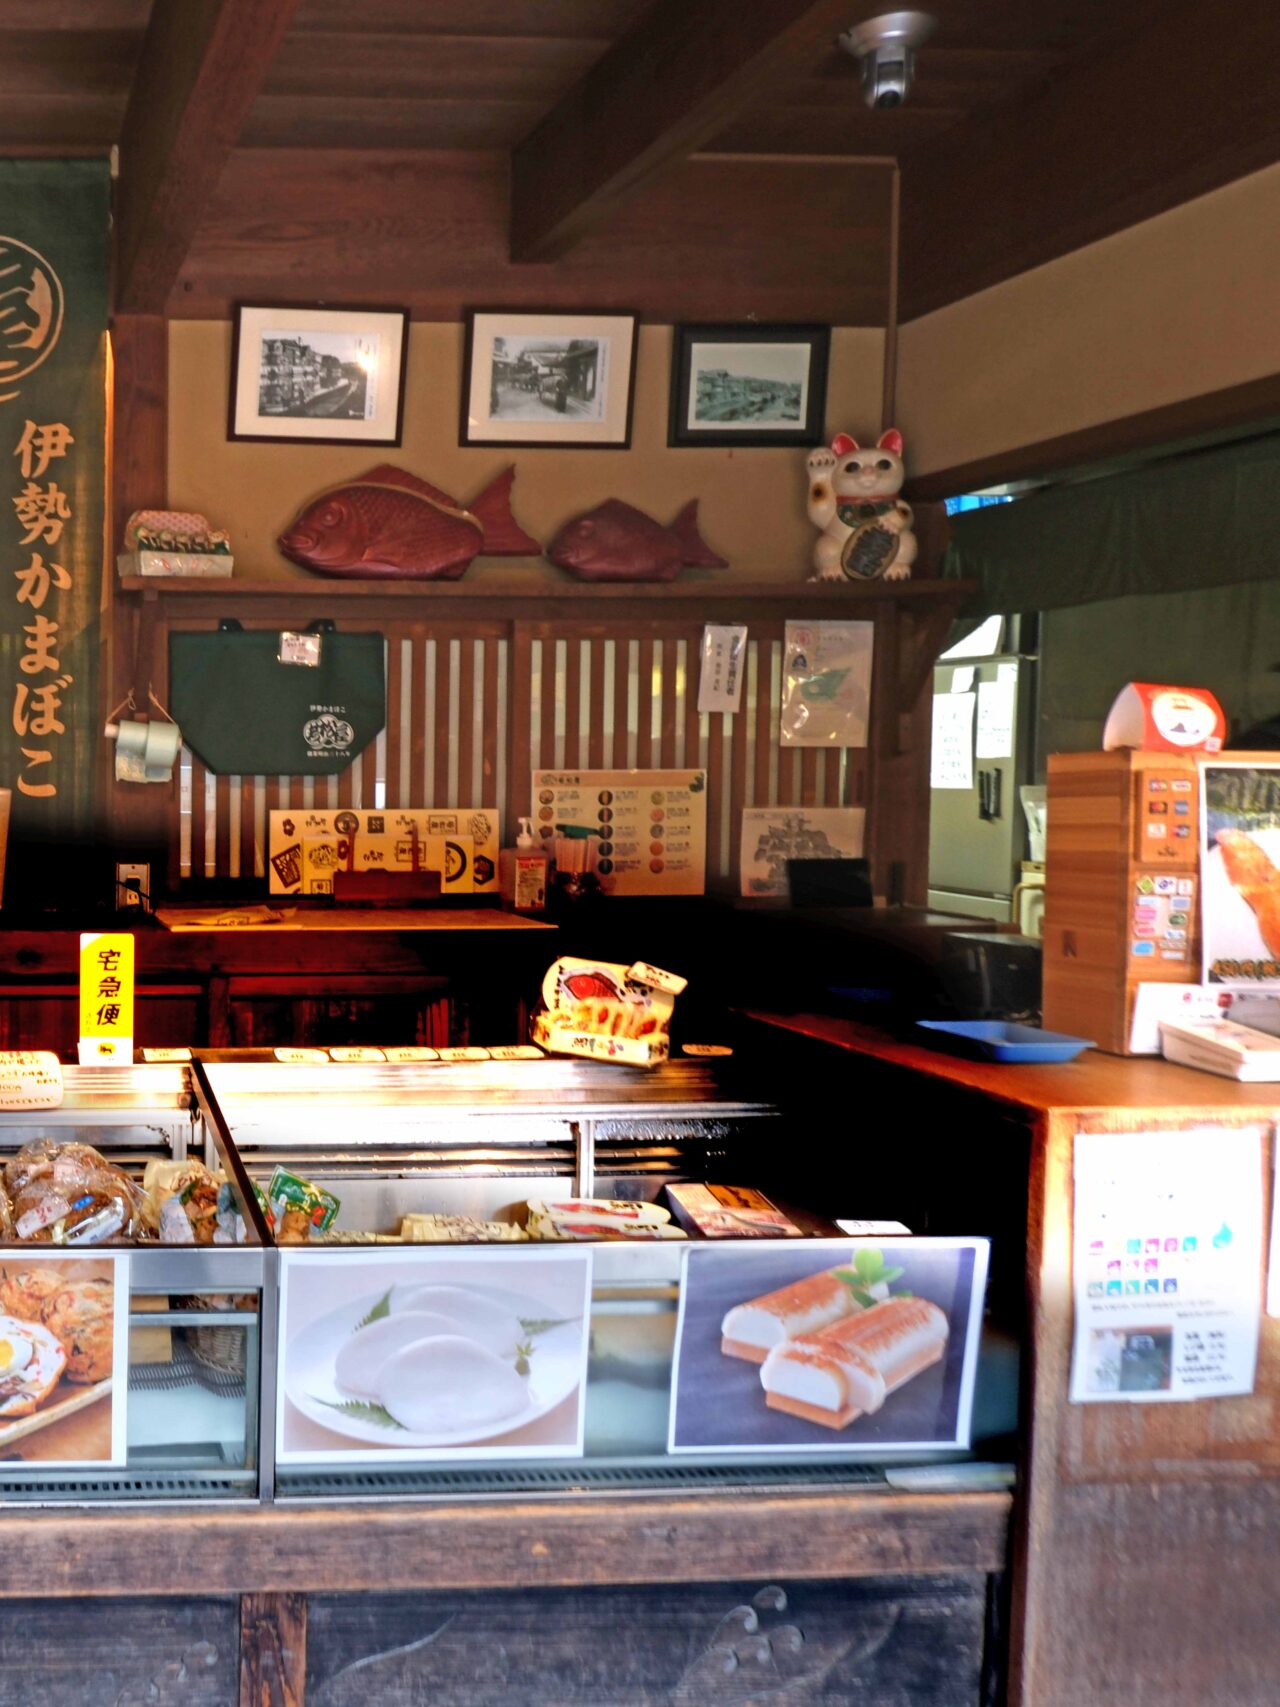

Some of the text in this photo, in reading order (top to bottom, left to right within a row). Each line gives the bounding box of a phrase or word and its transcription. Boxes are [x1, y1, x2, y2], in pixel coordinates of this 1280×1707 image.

[13, 419, 74, 798] 伊勢かまぼこ
[96, 949, 122, 1026] 宅急便
